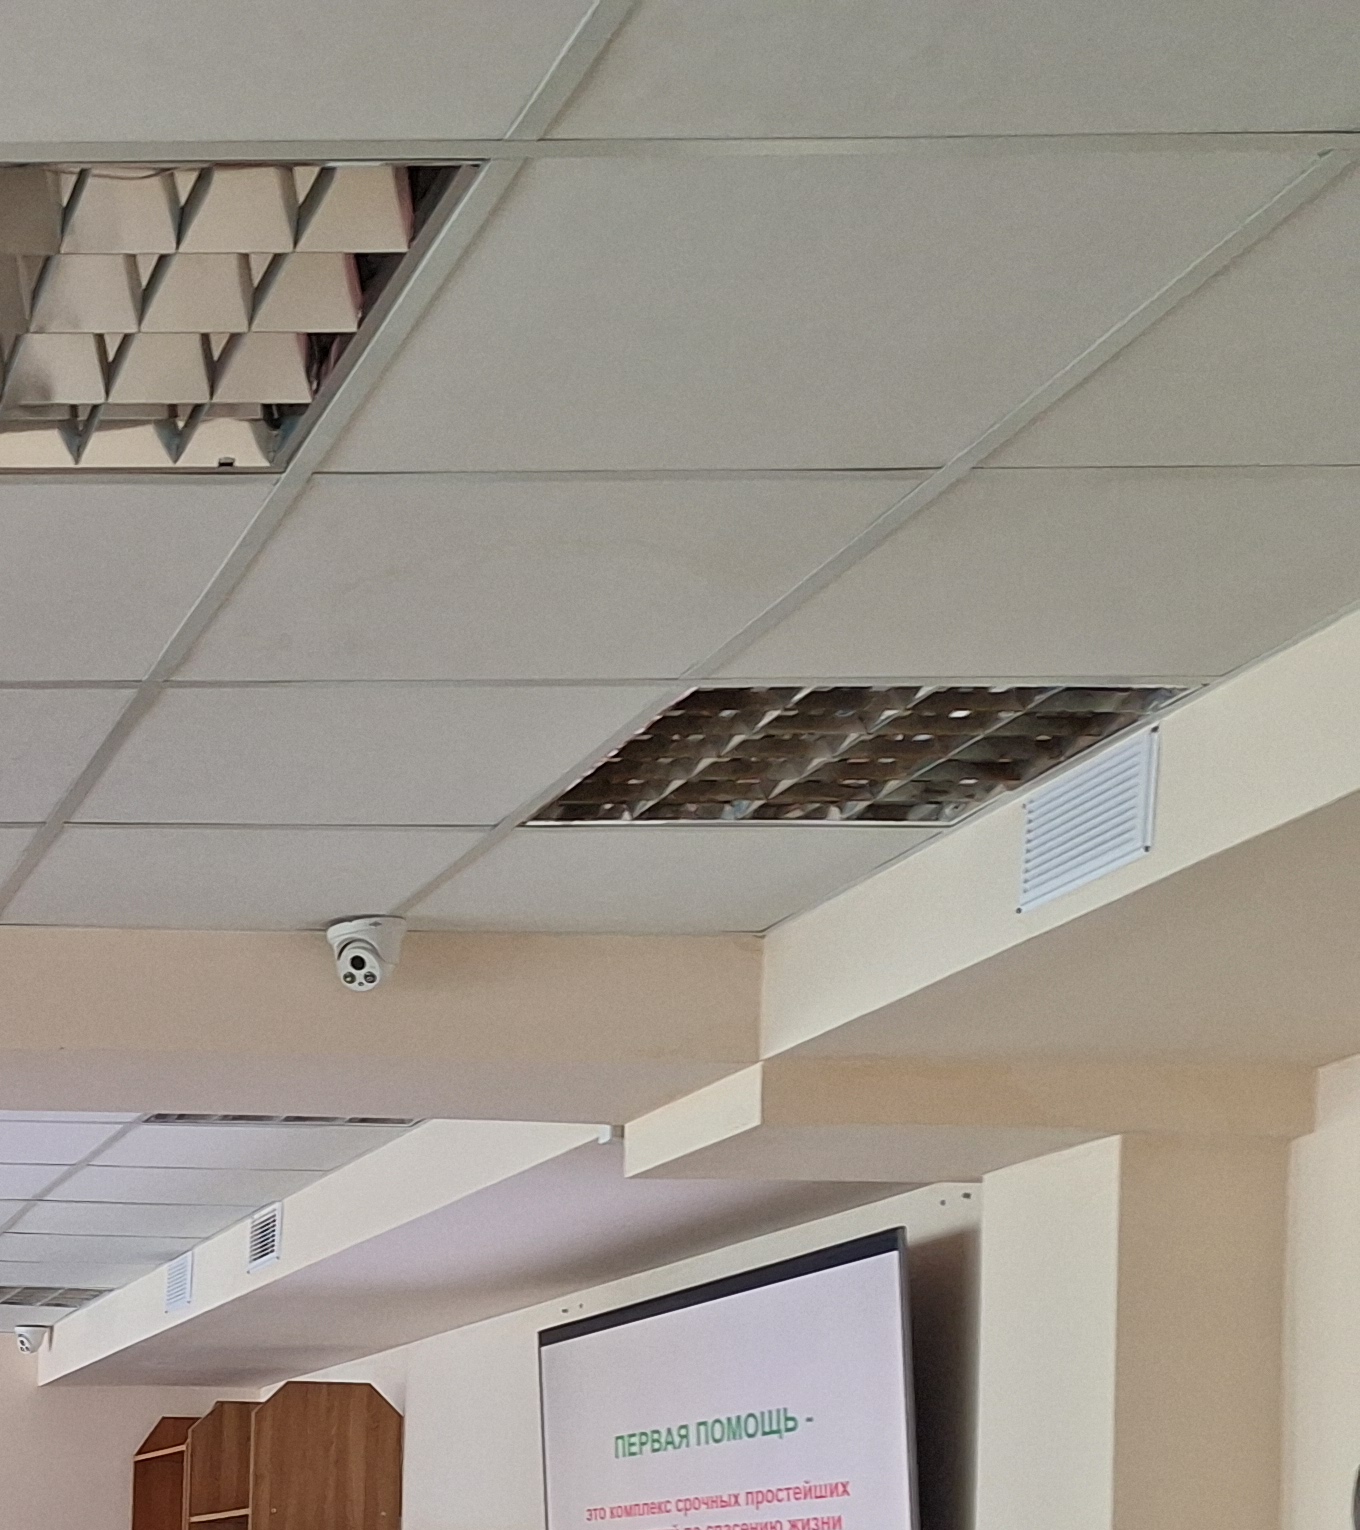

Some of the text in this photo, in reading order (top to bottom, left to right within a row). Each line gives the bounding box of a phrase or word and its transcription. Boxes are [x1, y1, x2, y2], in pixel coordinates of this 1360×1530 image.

[614, 1423, 690, 1459] ПЕРВАЯ
[696, 1407, 799, 1447] ПОМОЩЬ
[585, 1480, 850, 1522] это комплекс срочных простейших
